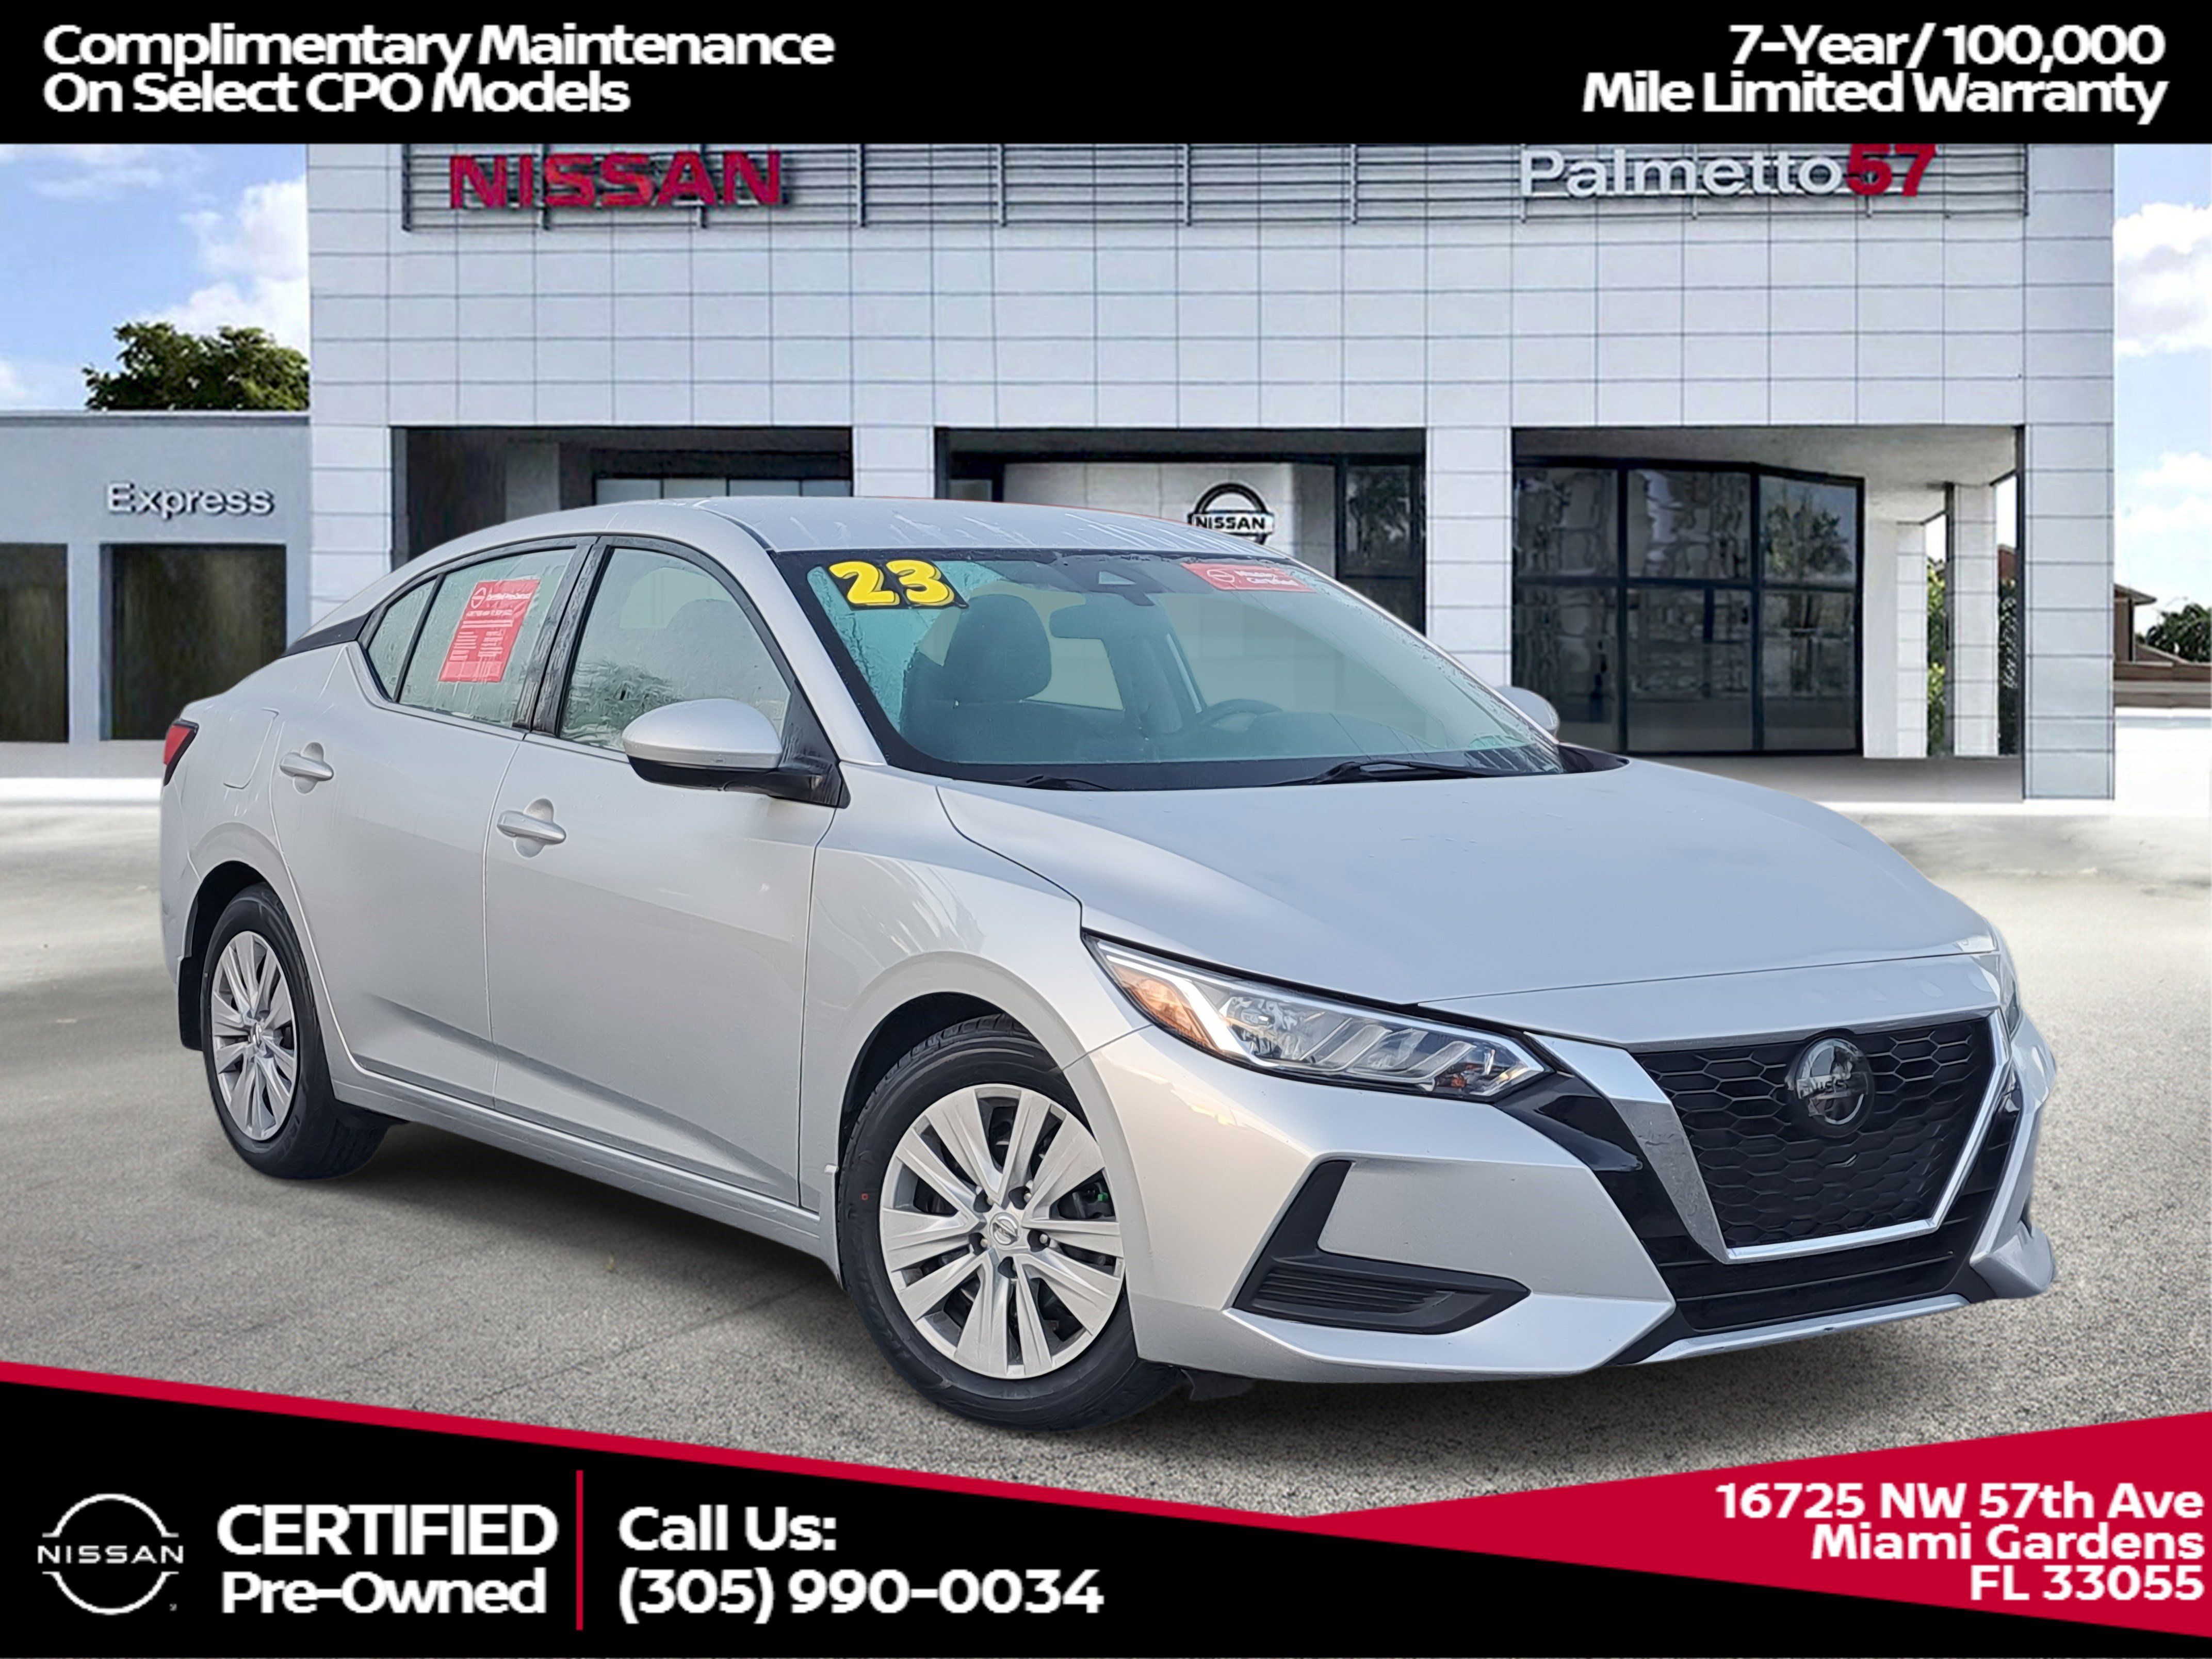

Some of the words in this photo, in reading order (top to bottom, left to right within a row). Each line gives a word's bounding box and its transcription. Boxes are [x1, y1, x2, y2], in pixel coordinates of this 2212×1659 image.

[449, 150, 782, 209] NISSAN
[108, 483, 275, 520] Express
[1195, 516, 1265, 530] NISSAN
[828, 559, 954, 607] 23
